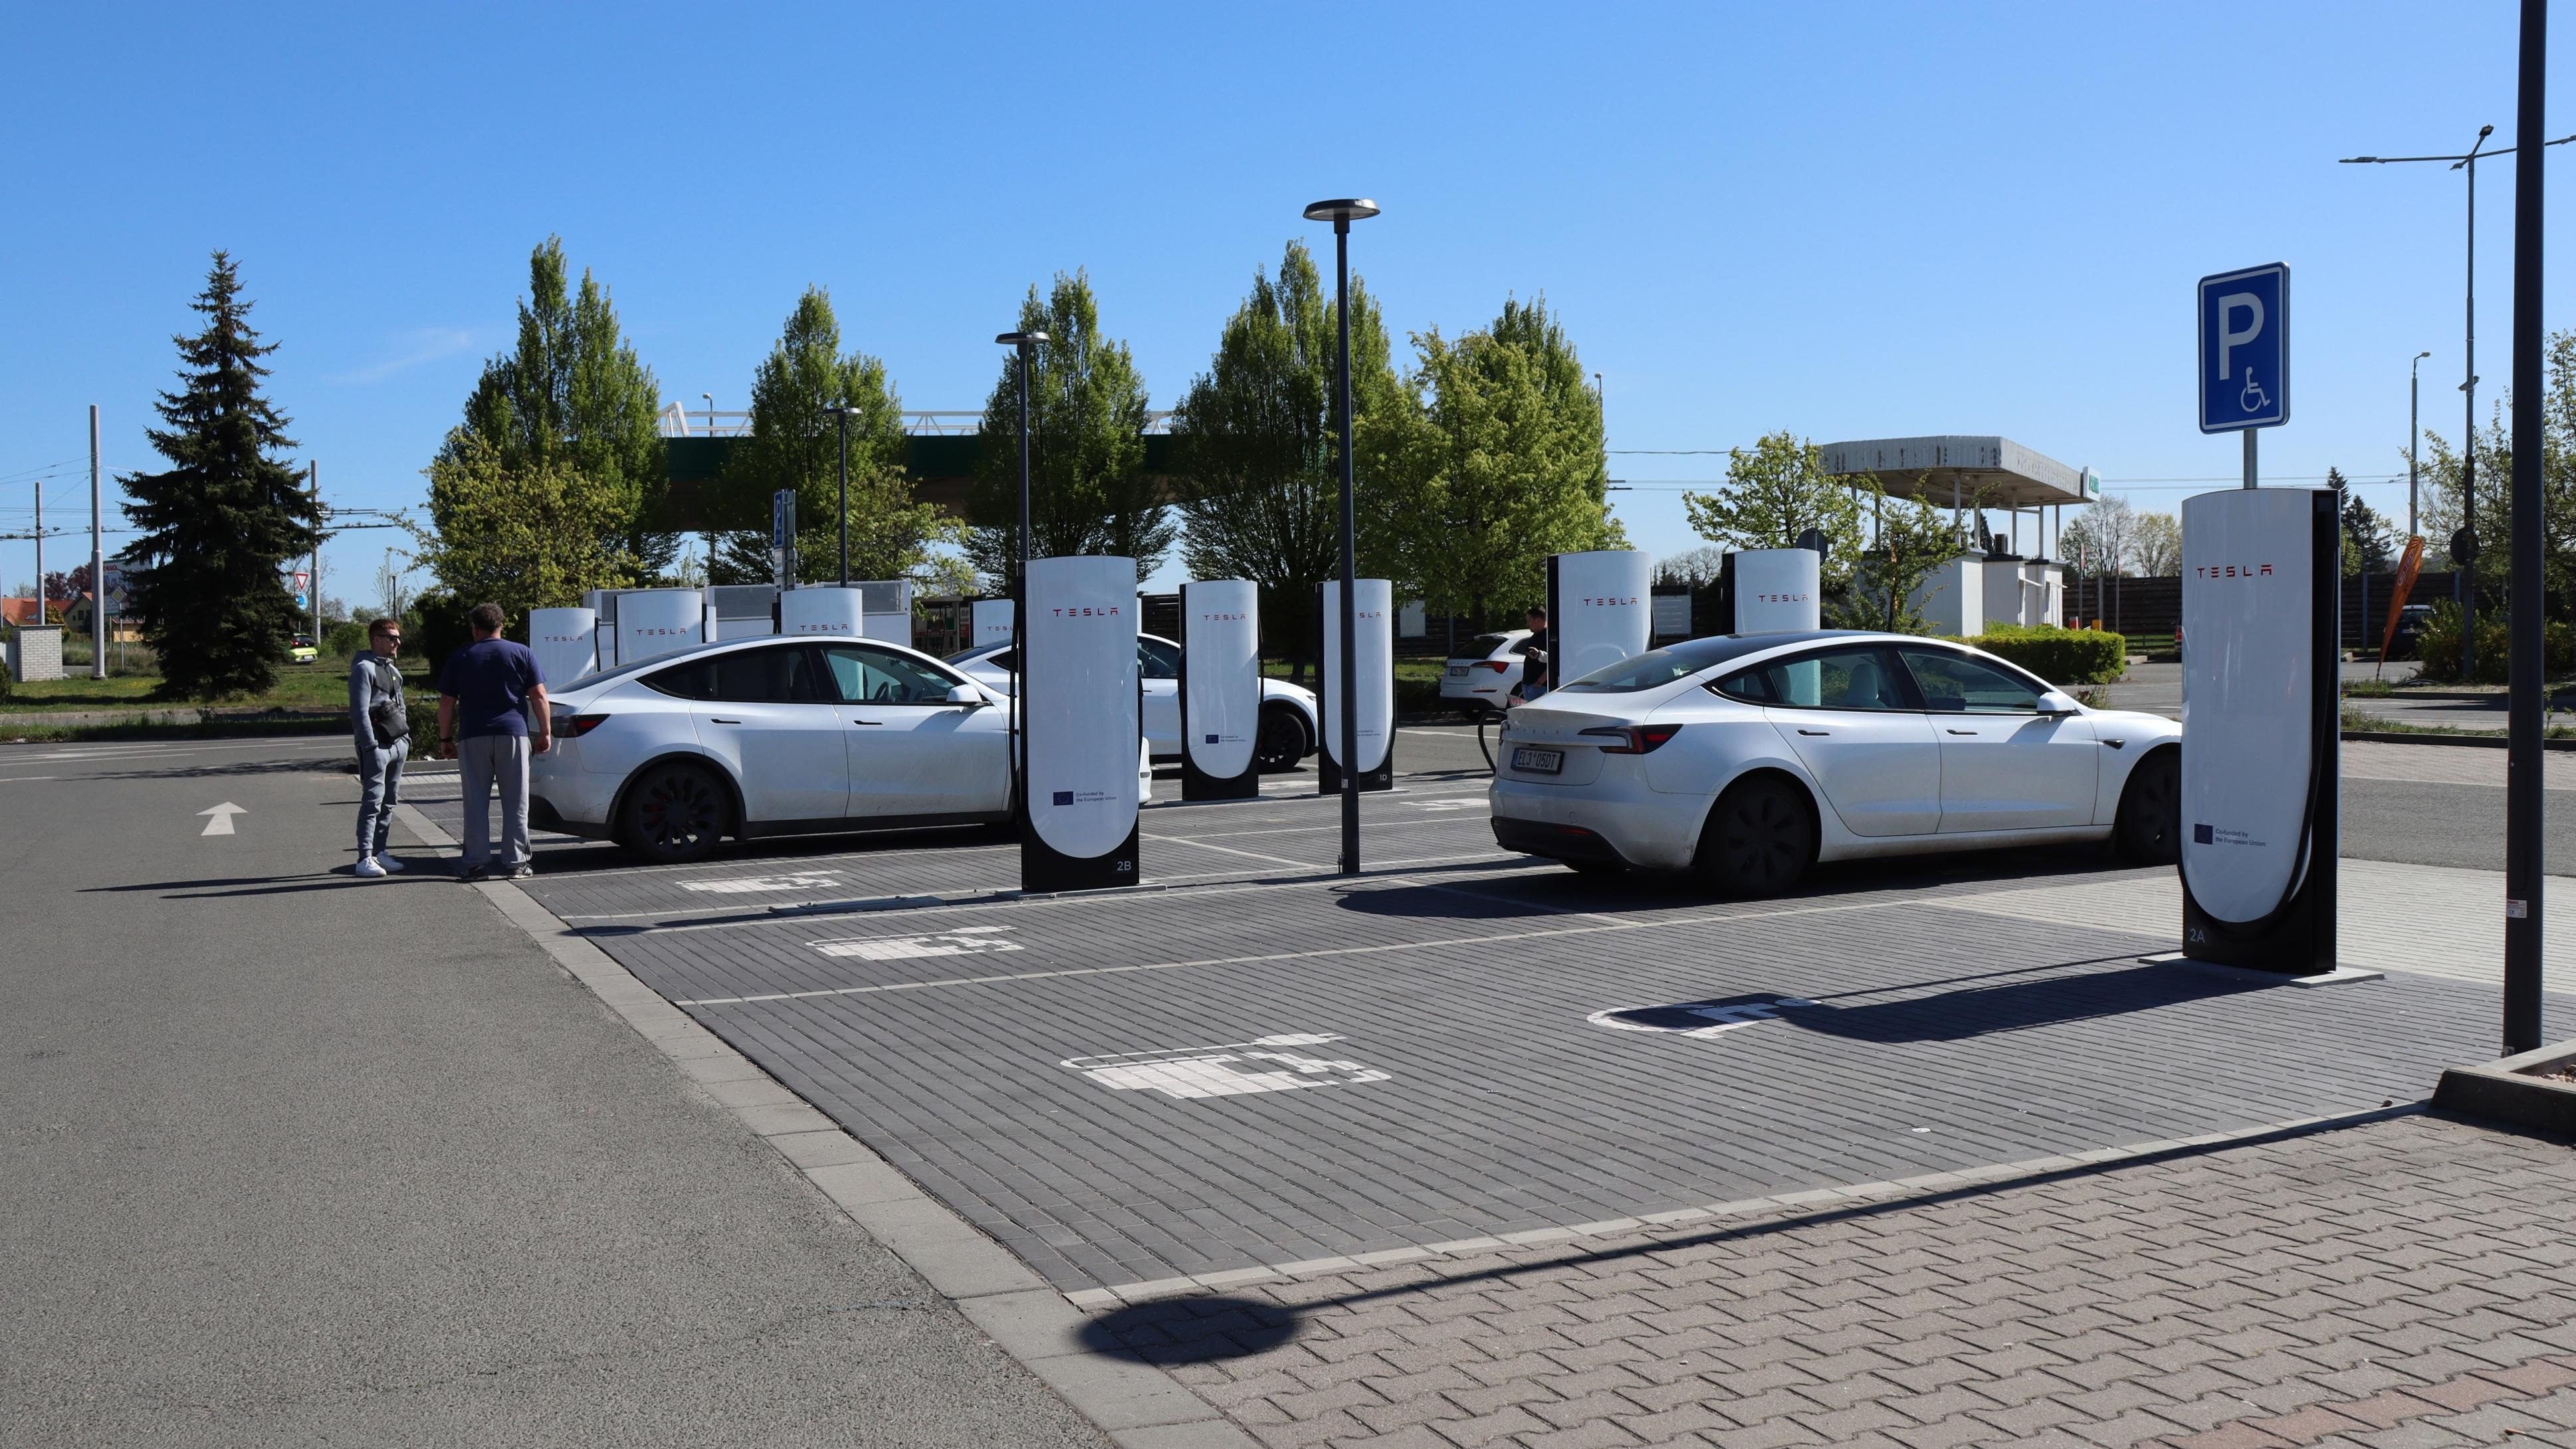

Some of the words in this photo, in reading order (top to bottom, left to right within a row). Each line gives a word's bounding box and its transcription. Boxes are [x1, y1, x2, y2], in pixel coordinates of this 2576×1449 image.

[2218, 292, 2264, 380] P
[2197, 564, 2272, 579] TESLA
[1583, 597, 1638, 606] TESLA
[1758, 594, 1808, 603] TESLA
[1053, 607, 1118, 617] TESLA
[1117, 861, 1132, 871] 2B
[2190, 927, 2205, 943] 2A
